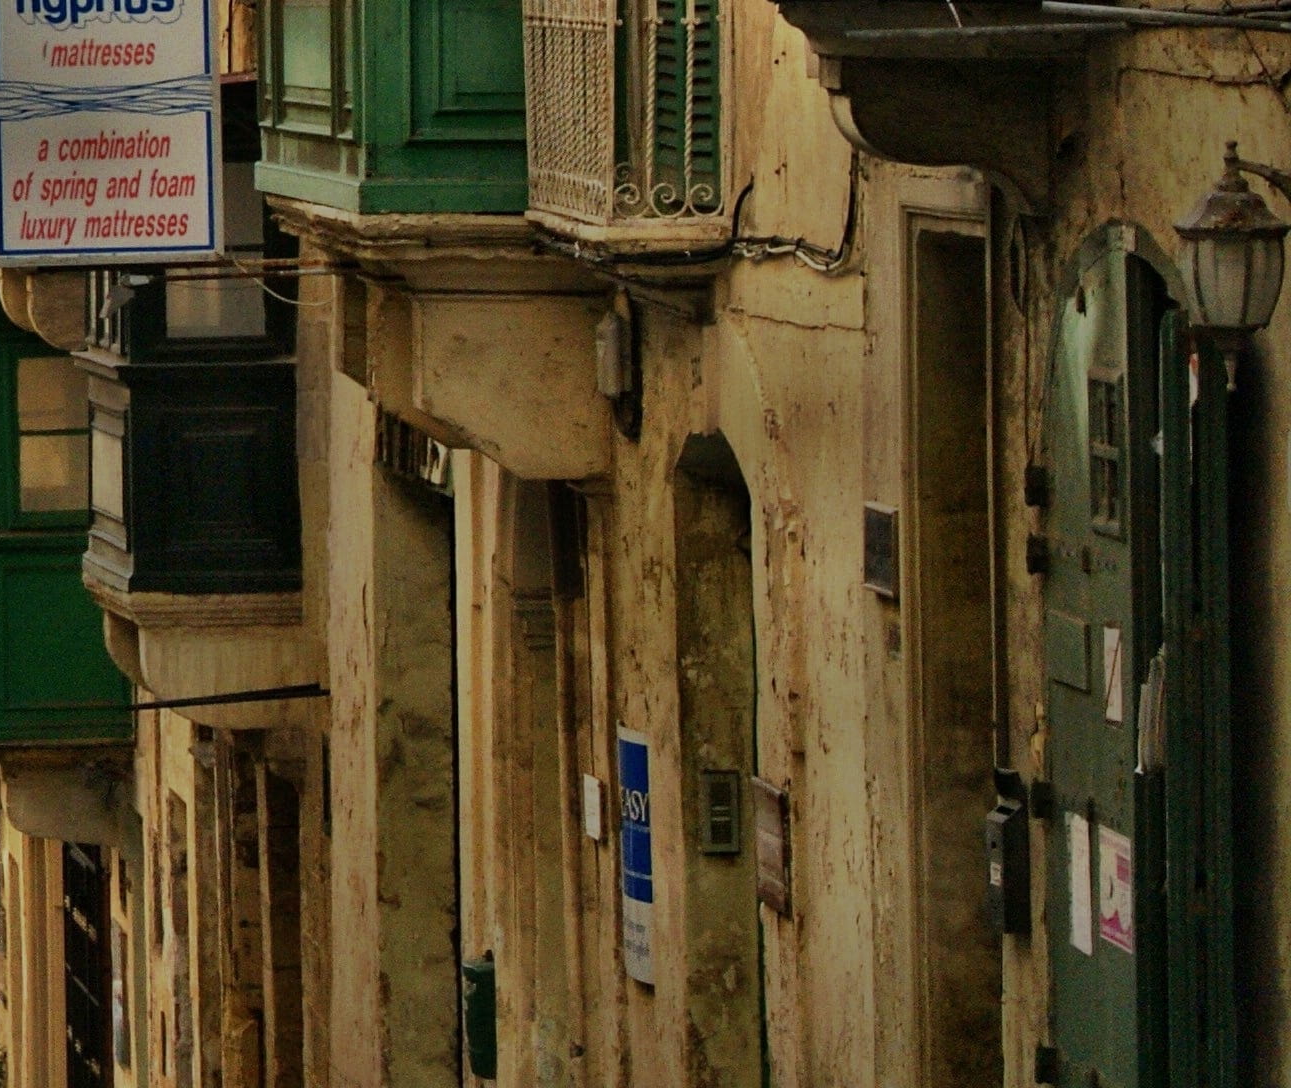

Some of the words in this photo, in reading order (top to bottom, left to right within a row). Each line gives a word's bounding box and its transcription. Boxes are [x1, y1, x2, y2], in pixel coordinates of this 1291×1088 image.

[51, 39, 156, 67] mattresses
[37, 143, 48, 162] a
[59, 129, 171, 161] combination
[12, 172, 33, 202] of
[41, 170, 98, 206] spring
[107, 170, 142, 199] and
[150, 169, 196, 198] foam
[20, 211, 76, 245] luxury
[84, 211, 189, 239] mattresses
